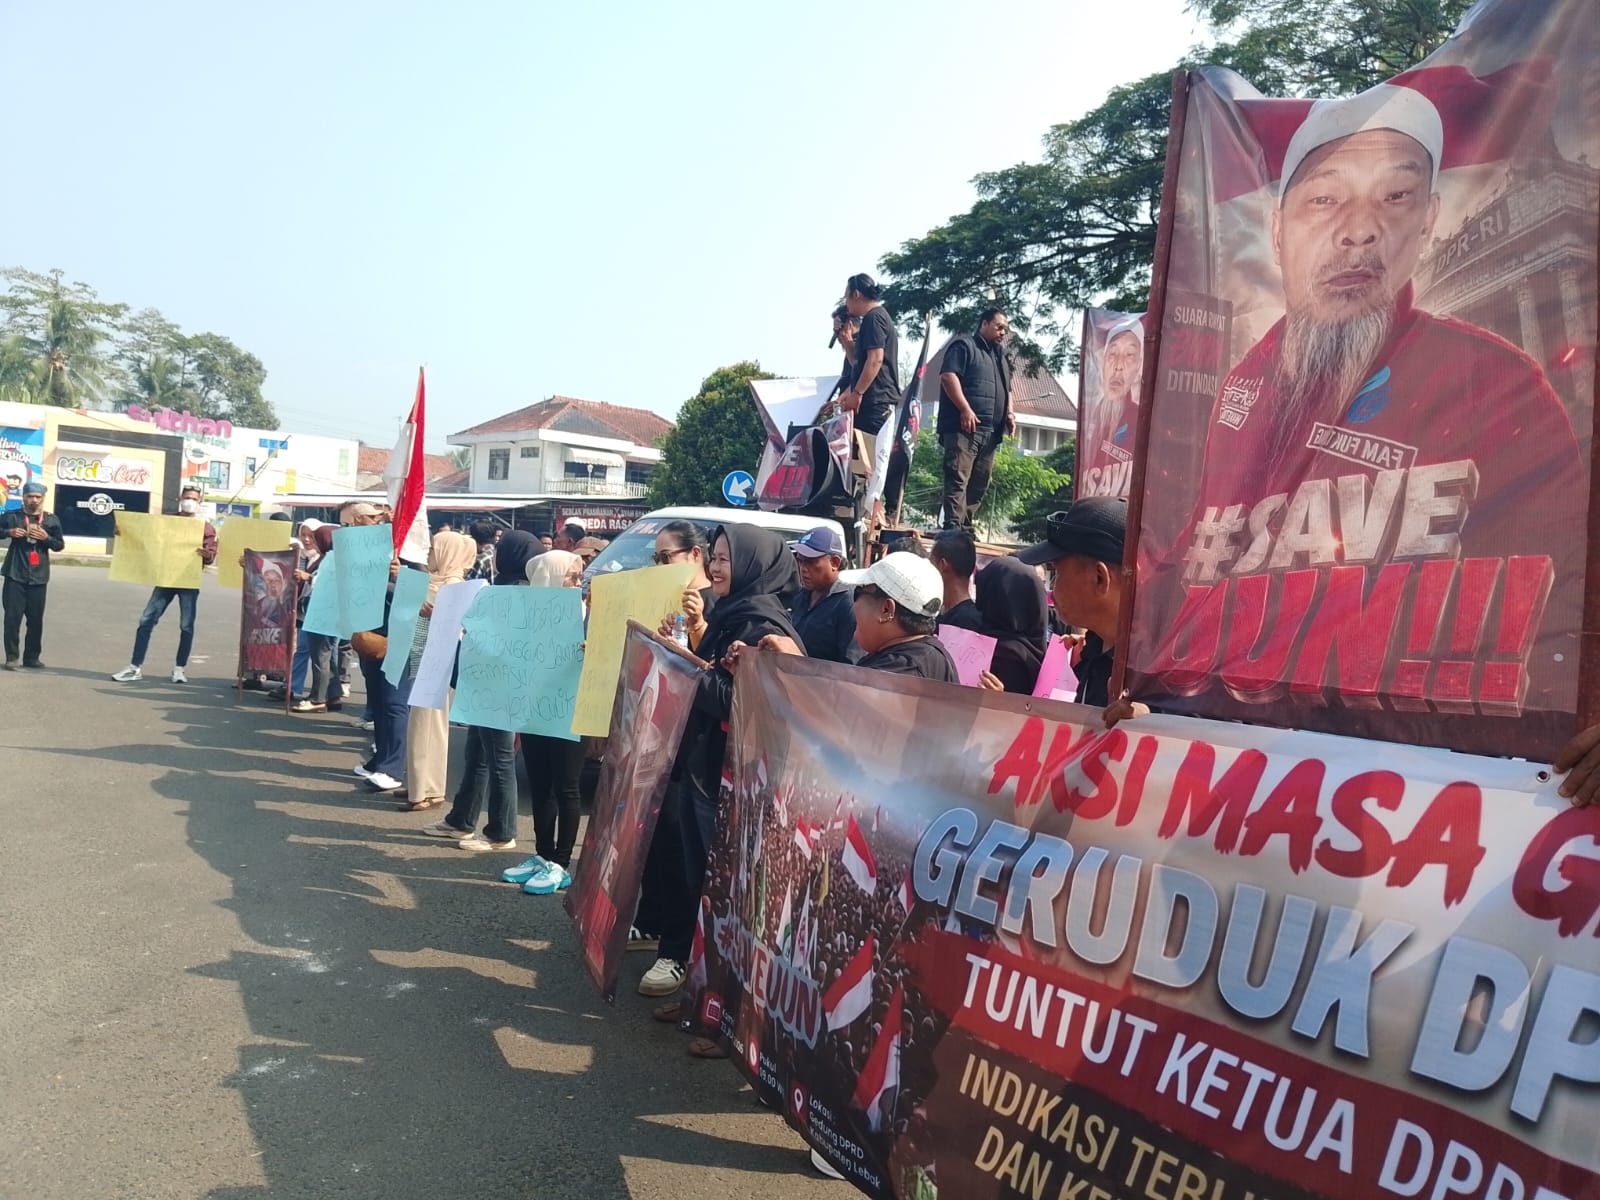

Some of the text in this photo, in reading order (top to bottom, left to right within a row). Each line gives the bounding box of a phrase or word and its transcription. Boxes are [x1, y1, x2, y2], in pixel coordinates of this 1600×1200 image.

[1434, 209, 1504, 274] DPR-RI
[1174, 306, 1207, 326] SUARA
[57, 457, 113, 483] Kids
[1182, 458, 1480, 586] #SAVE
[987, 715, 1158, 827] AKSI
[1158, 740, 1487, 910] MASA
[913, 808, 1415, 1059] GERUDUK
[963, 953, 1158, 1078] TUNTUT
[1155, 1032, 1355, 1174] KETUA
[810, 1094, 832, 1120] Lokasi
[810, 1111, 864, 1160] Gedung DPRD
[959, 1053, 1120, 1172] INDIKASI
[853, 1161, 881, 1188] Lebak
[975, 1126, 1052, 1200] DAN
